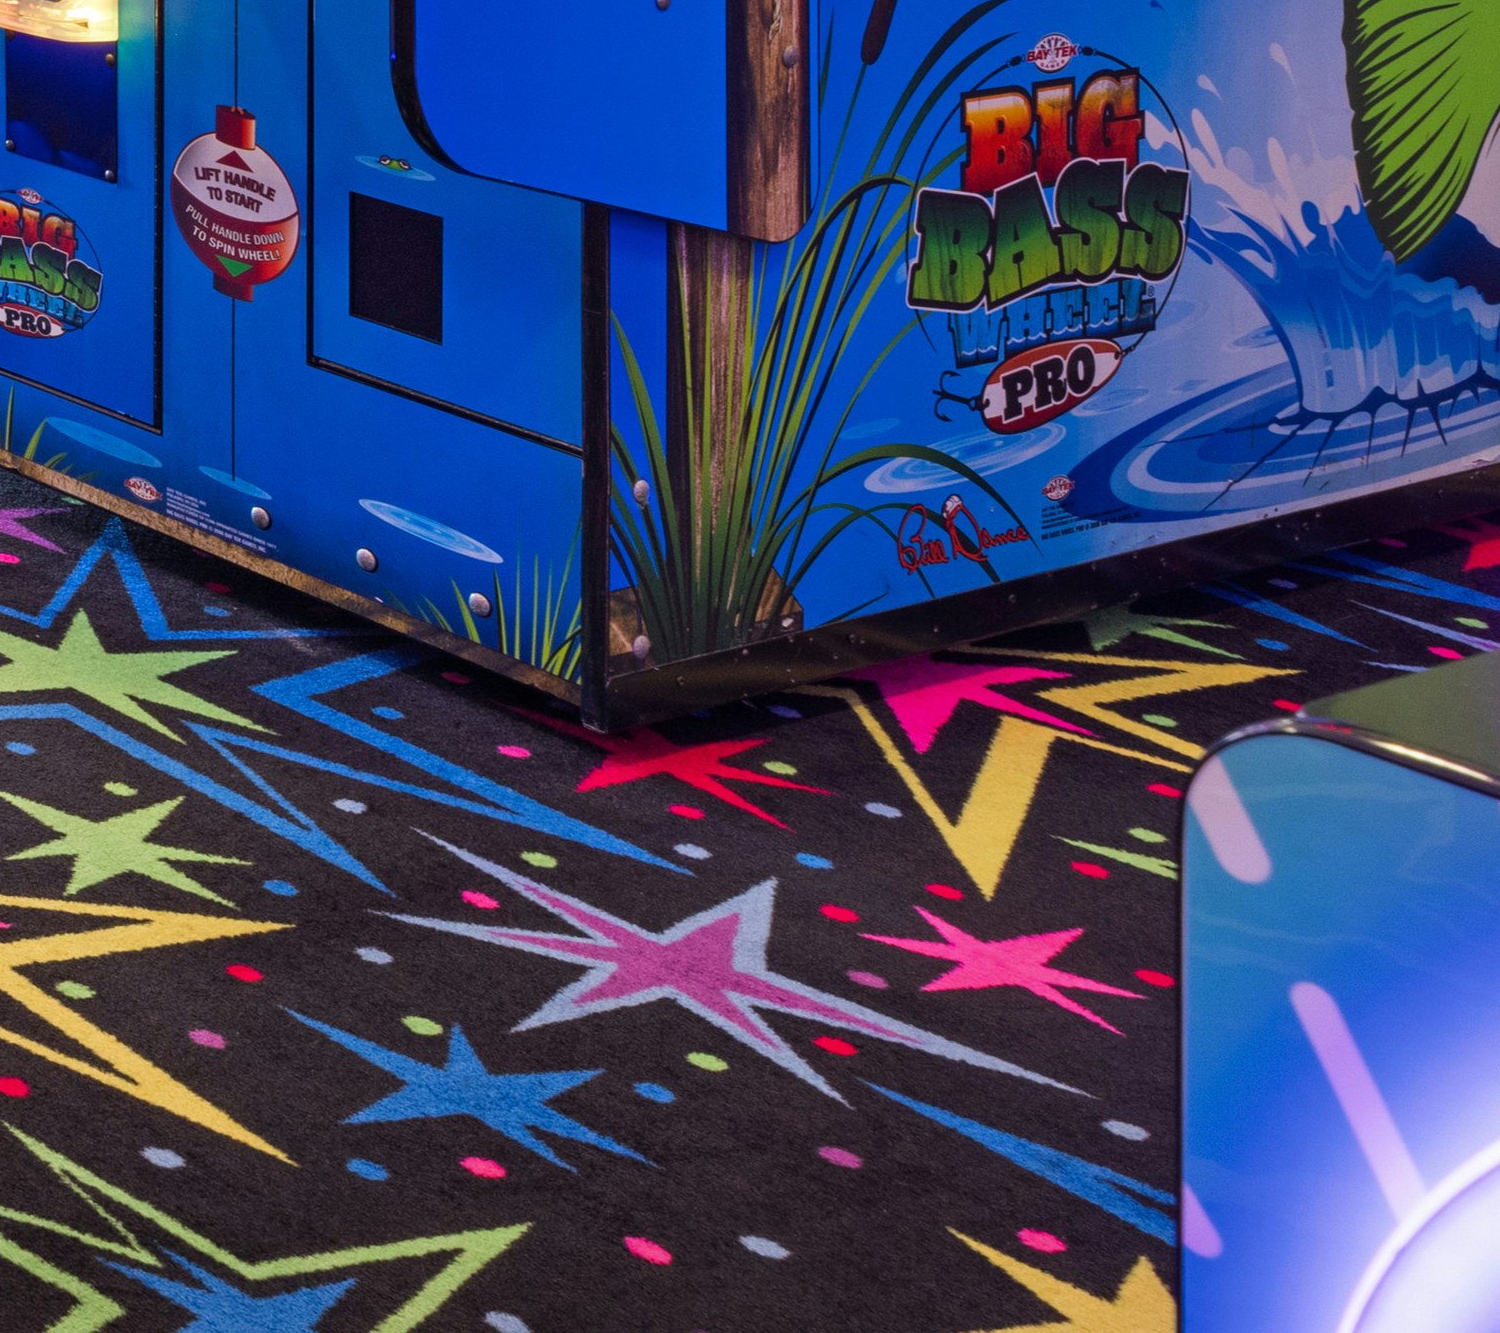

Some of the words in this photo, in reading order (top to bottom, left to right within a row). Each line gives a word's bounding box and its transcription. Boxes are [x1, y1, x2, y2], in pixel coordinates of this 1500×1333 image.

[1026, 49, 1050, 62] BAY
[1054, 44, 1079, 58] TEK
[960, 67, 1146, 199] BIG
[195, 166, 221, 183] LIFT
[224, 169, 277, 202] HANDLE
[206, 185, 222, 201] TO
[225, 188, 263, 213] START
[185, 204, 209, 231] PULL
[211, 222, 252, 245] HANDLE
[253, 230, 285, 246] DOWN
[191, 225, 208, 243] TO
[208, 236, 236, 258] SPIN
[238, 248, 282, 262] WHEEL!
[907, 158, 1191, 314] BASS
[3, 308, 53, 337] PRO
[948, 281, 1158, 368] WHEEL
[1001, 341, 1097, 424] PRO
